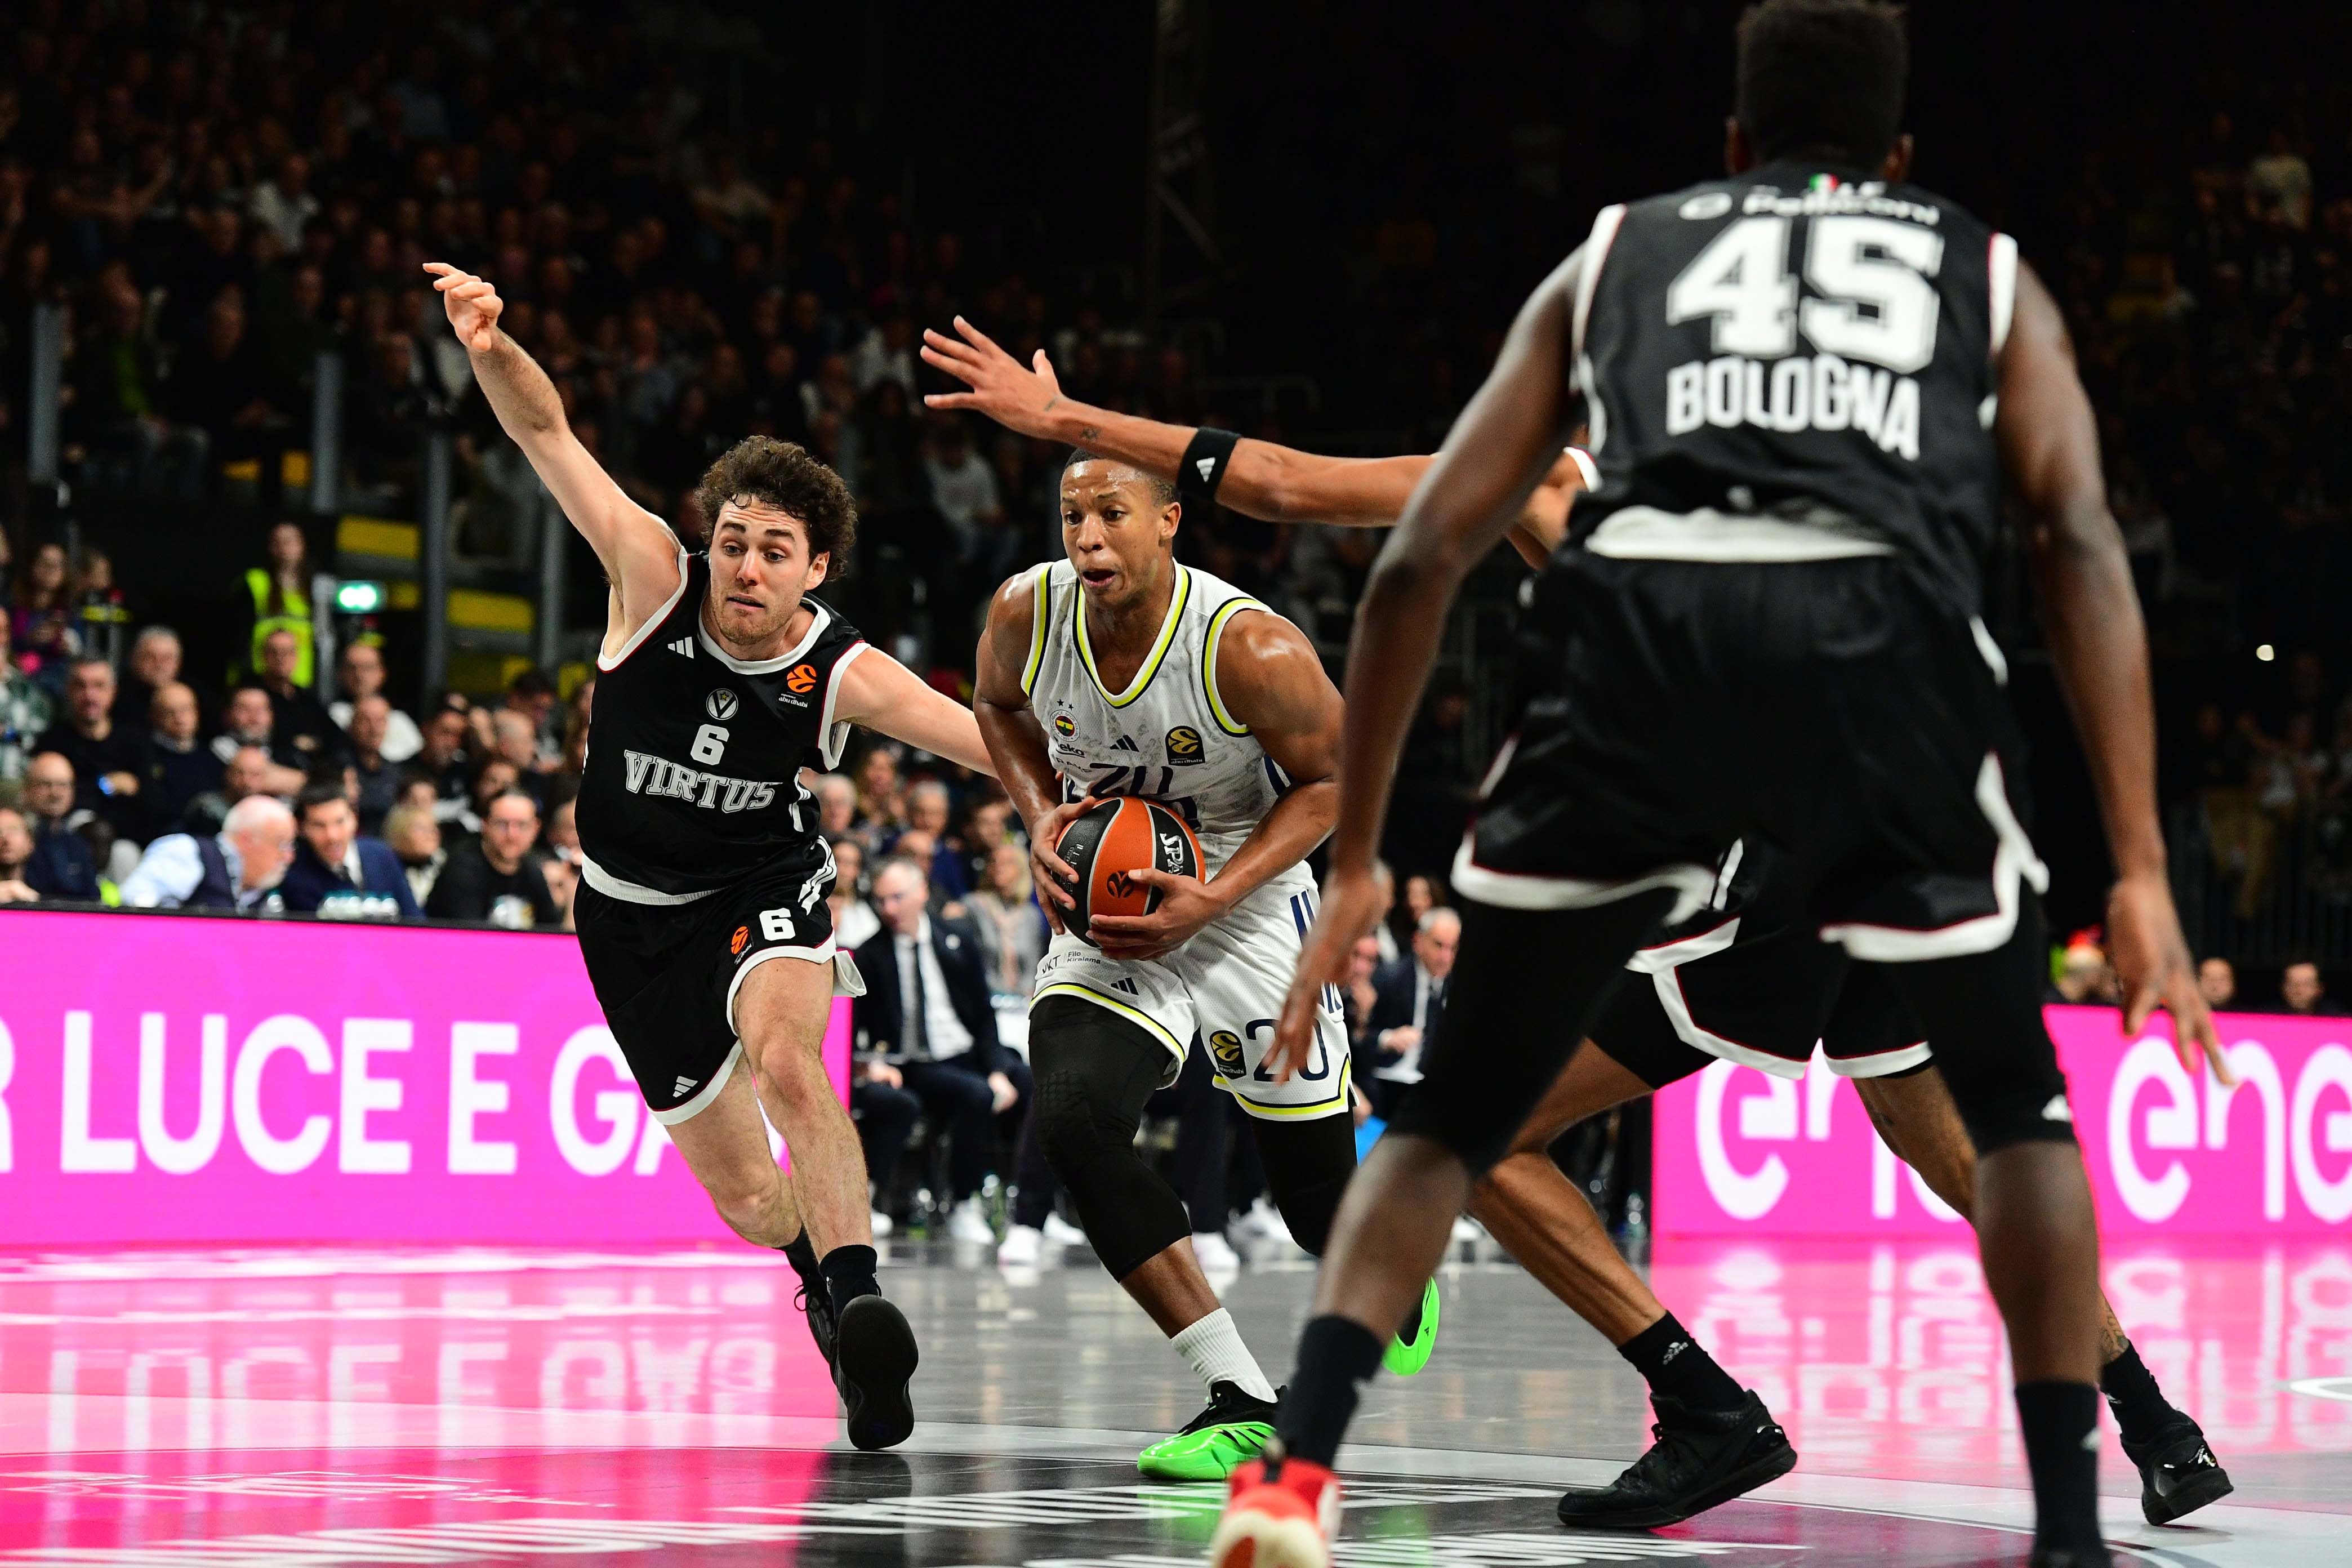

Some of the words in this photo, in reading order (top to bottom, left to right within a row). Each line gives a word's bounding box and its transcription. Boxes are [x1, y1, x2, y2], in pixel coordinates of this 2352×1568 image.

[1665, 216, 1946, 374] 45
[1666, 352, 1921, 461] BOLOGNA
[691, 724, 730, 765] 6
[624, 749, 783, 813] VIRTUS
[759, 907, 796, 941] 6
[1245, 1019, 1329, 1081] 20
[60, 1012, 412, 1174] LUCE
[447, 1022, 518, 1174] E
